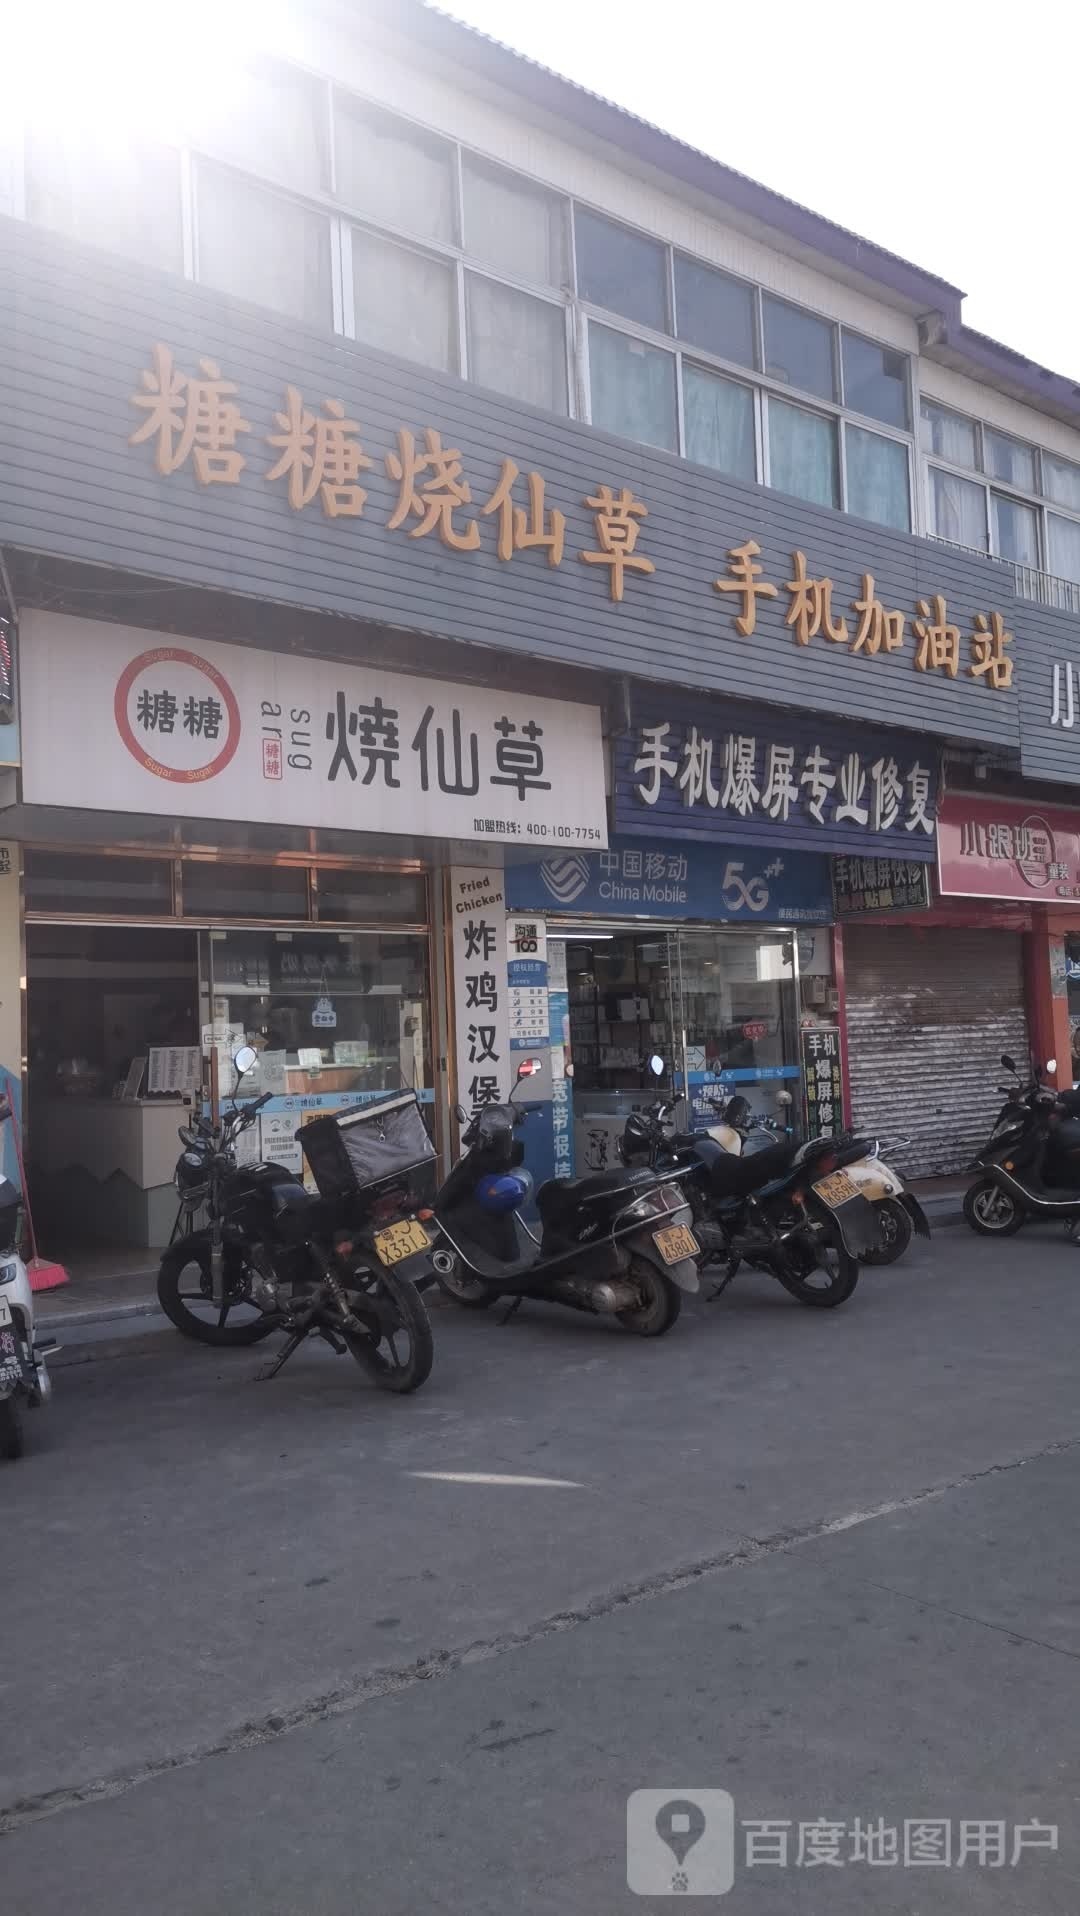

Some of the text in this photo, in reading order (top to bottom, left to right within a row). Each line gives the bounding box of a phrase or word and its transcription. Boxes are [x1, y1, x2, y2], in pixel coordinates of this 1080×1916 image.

[129, 344, 1014, 689] 糖糖烧仙草 手机加油站
[136, 689, 223, 739] 糖糖
[634, 722, 935, 834] 手机爆屏专业修复
[526, 823, 601, 840] 400-100-7754
[599, 848, 688, 881] 中国移动
[459, 877, 490, 894] Fried
[599, 881, 688, 904] China Mobile
[455, 893, 503, 914] Chicken
[514, 924, 538, 938] 沟通
[463, 920, 501, 1123] 炸鸡汉堡
[809, 1033, 837, 1056] 手机
[380, 1230, 428, 1264] X331J
[664, 1237, 695, 1260] 43801
